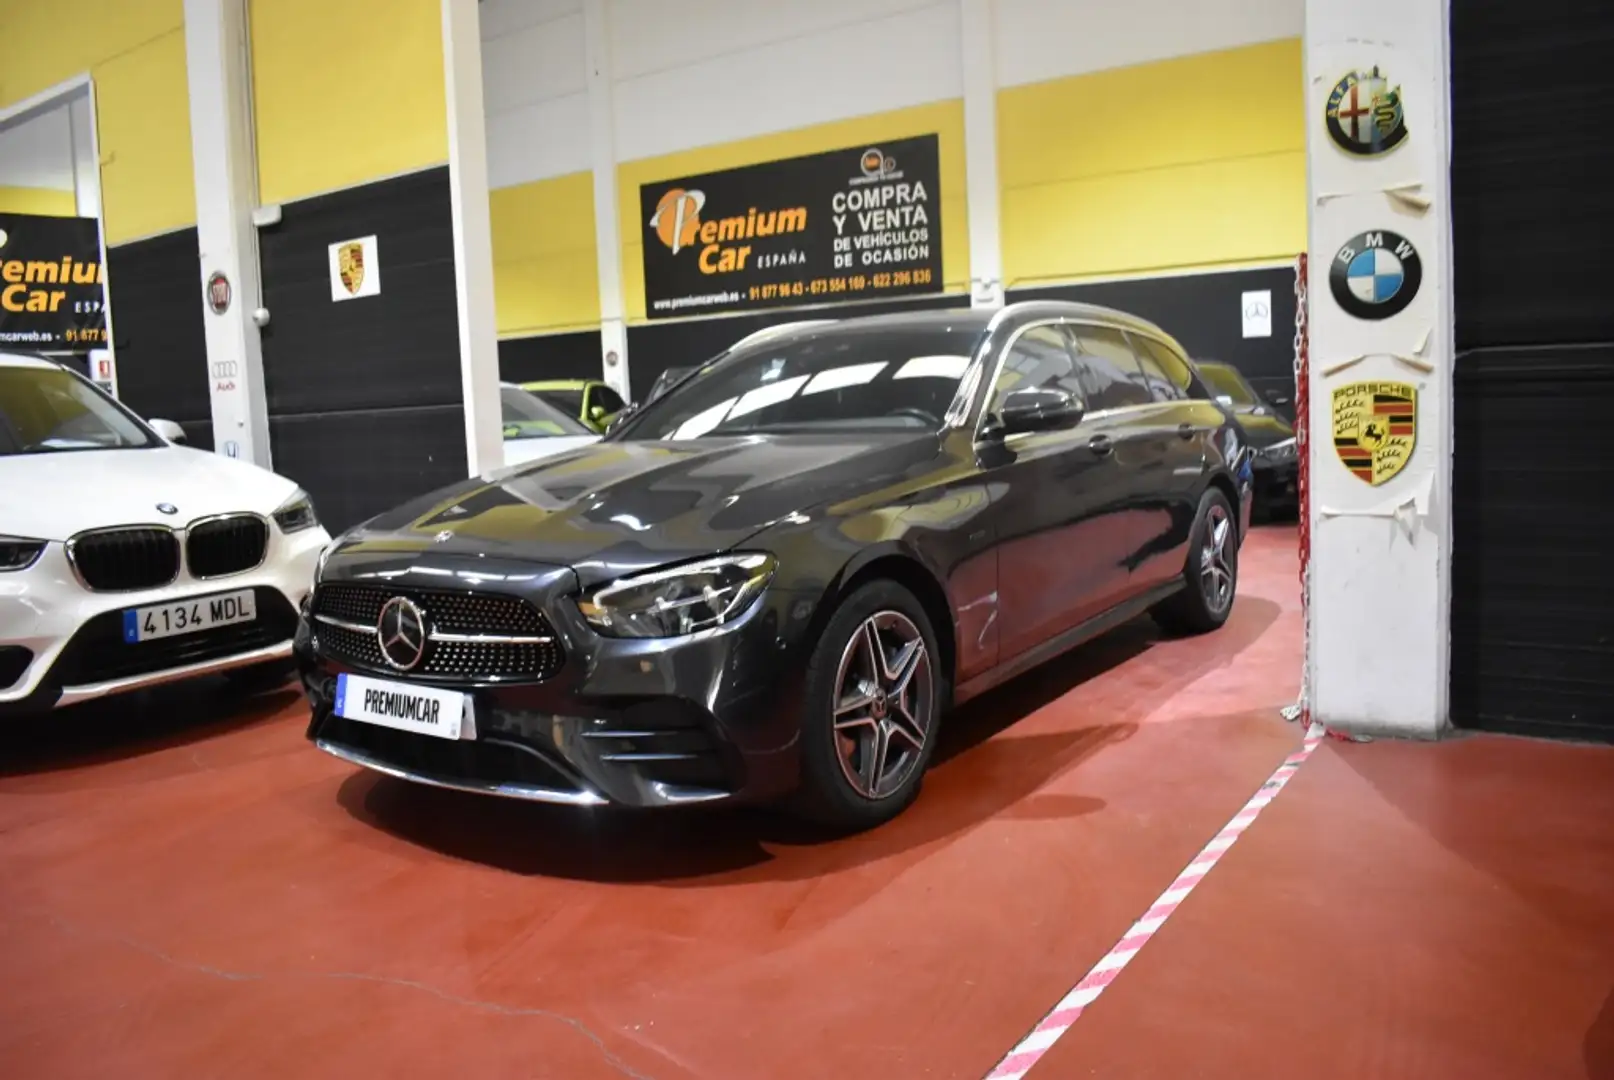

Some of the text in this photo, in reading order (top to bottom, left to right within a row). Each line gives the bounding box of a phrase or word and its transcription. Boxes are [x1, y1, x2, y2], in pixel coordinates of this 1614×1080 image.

[832, 181, 928, 213] COMPRA
[650, 188, 807, 256] Premium
[832, 204, 928, 235] Y VENTA
[698, 243, 807, 274] Car ESPAÑA
[833, 236, 851, 253] DE
[834, 242, 930, 269] DE OCASIÓN
[1338, 232, 1414, 264] BMW
[0, 256, 104, 284] emiu
[1, 283, 66, 313] Car
[1333, 383, 1412, 400] PORSCHE
[144, 595, 250, 634] 4134 MDL
[363, 688, 441, 725] PREMIUMCAR
